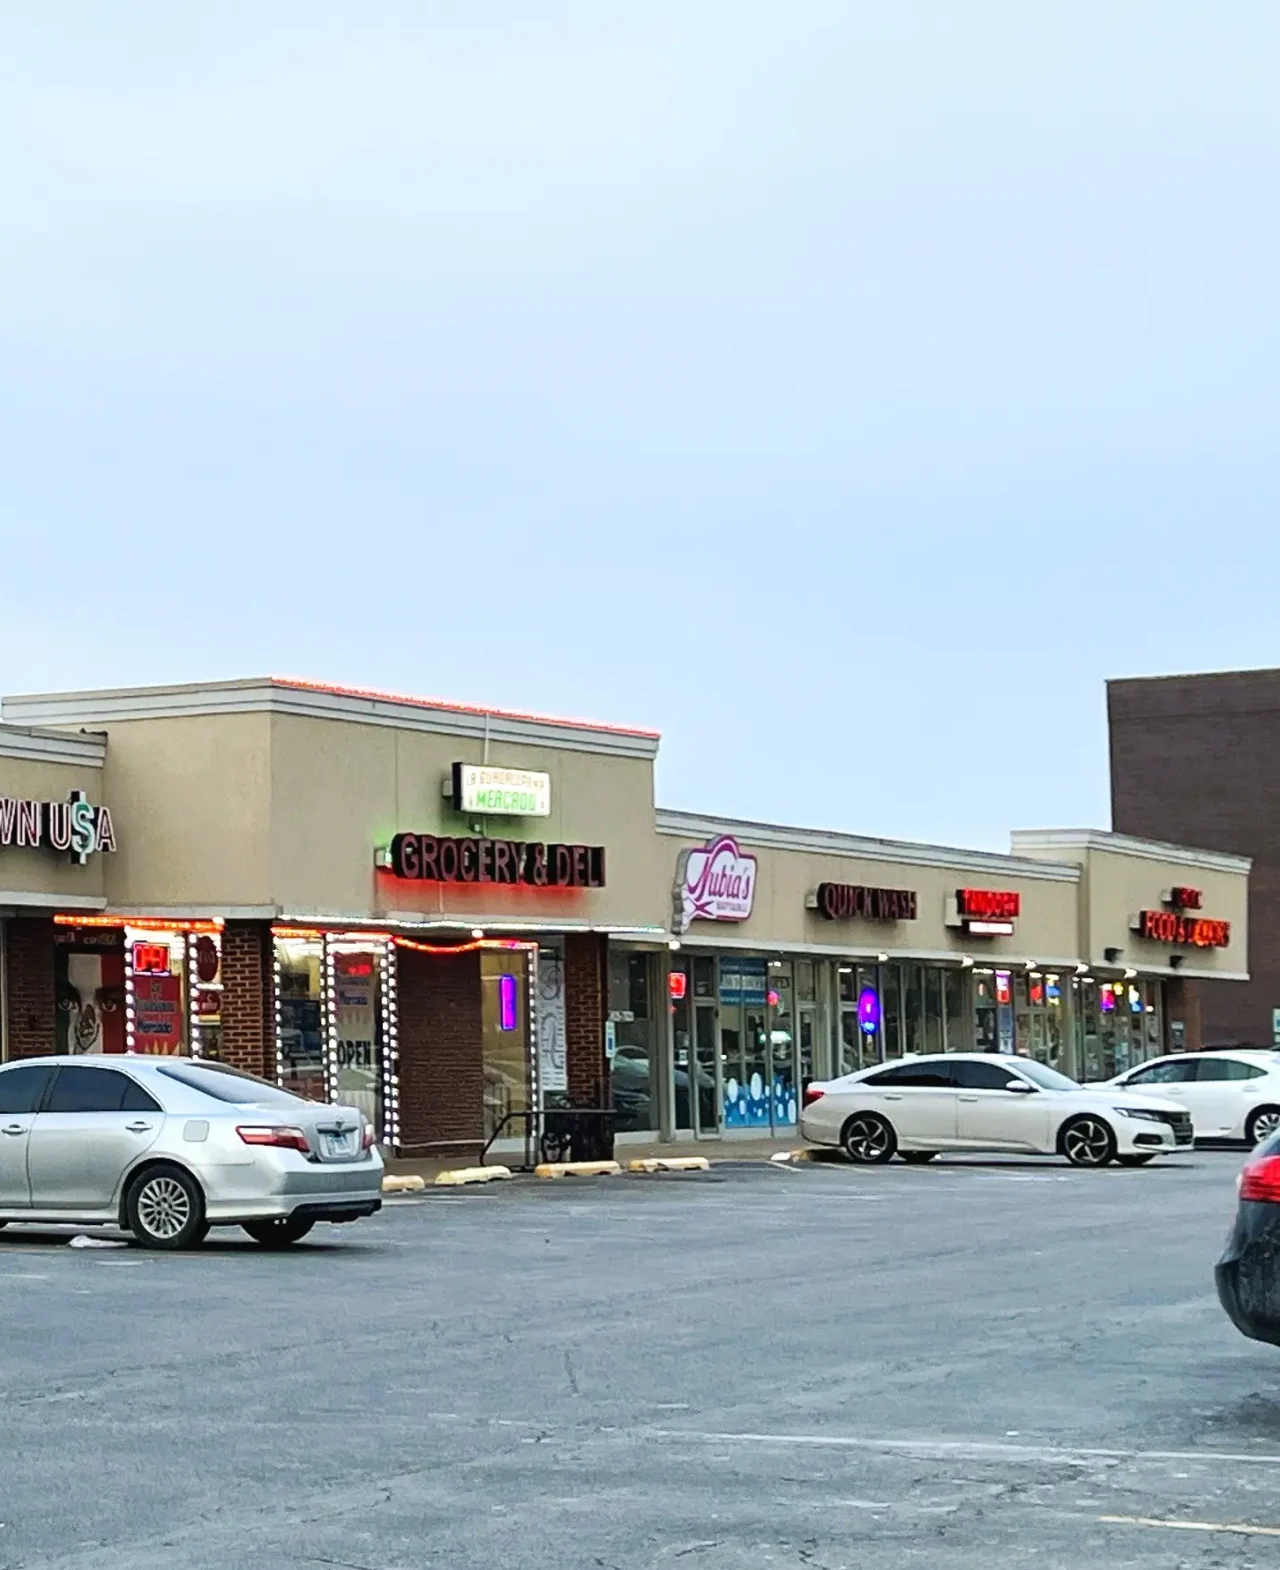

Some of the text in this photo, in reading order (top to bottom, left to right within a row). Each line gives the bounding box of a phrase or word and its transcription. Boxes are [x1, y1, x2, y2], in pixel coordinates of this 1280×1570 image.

[476, 789, 537, 811] MERCADO
[400, 834, 526, 884] GROCERY
[533, 844, 549, 887] &
[336, 1040, 371, 1066] OPEN
